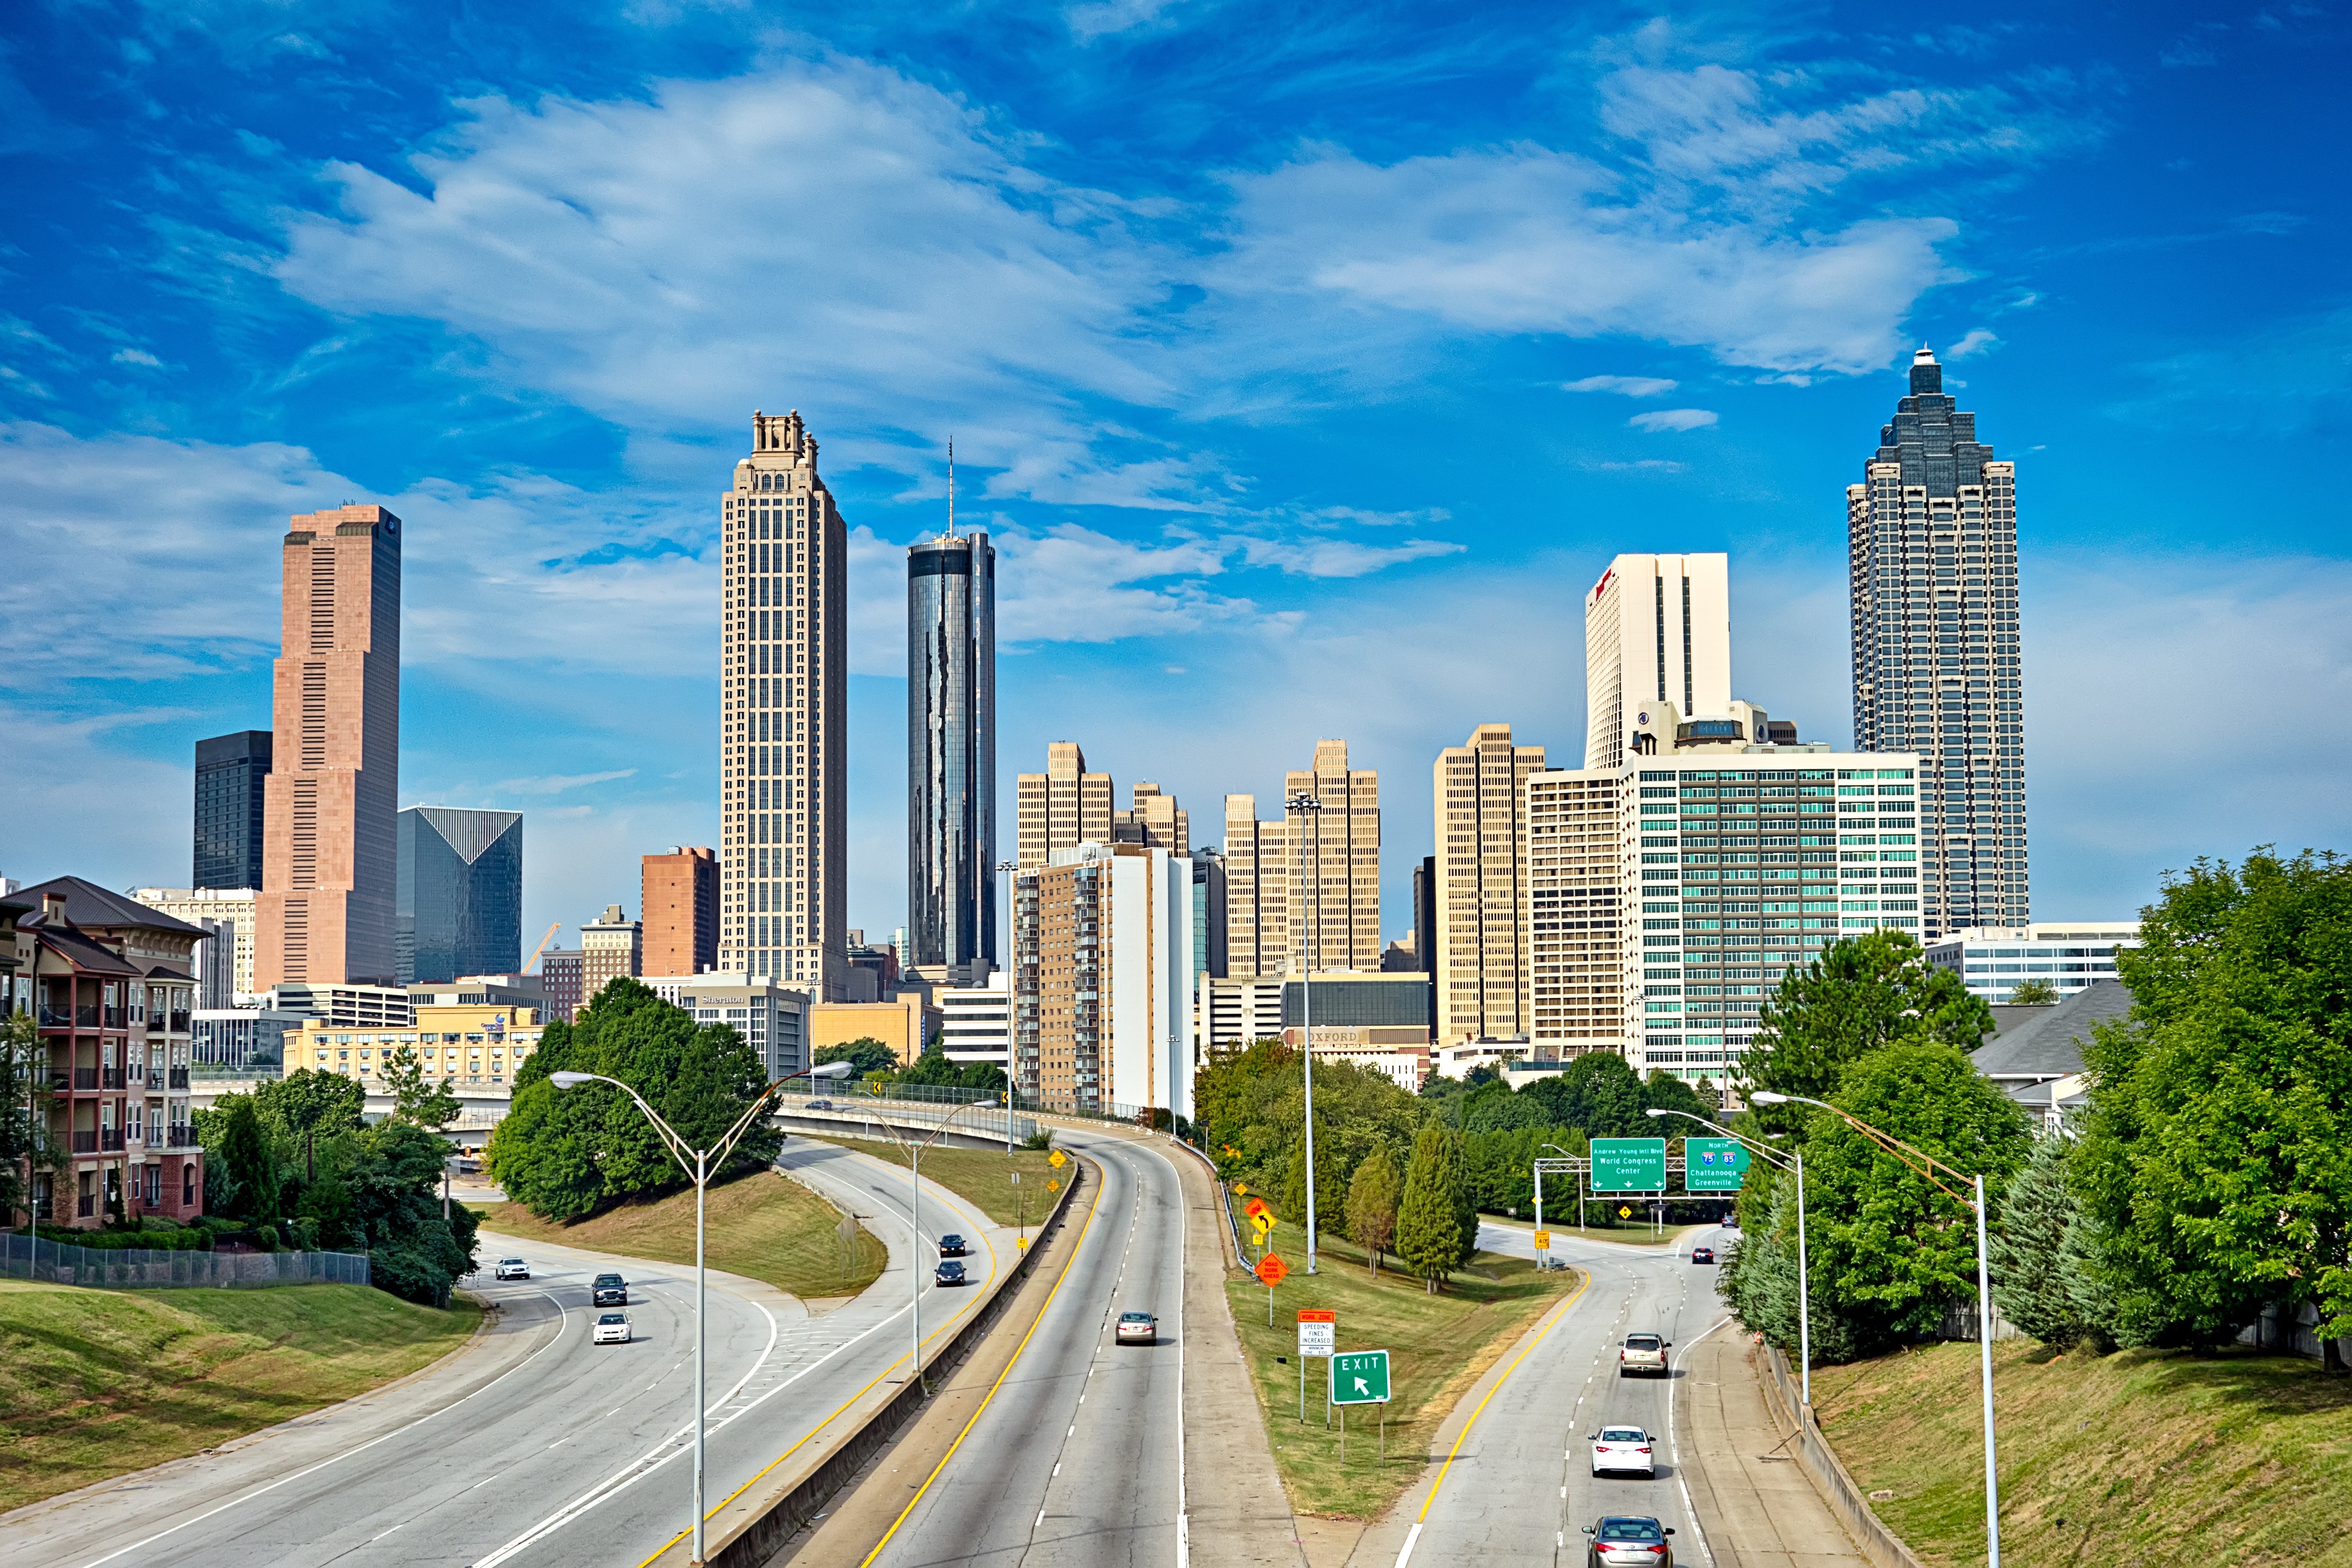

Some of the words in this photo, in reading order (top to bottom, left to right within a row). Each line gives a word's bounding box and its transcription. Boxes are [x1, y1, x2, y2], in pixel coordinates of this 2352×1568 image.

[702, 995, 744, 1004] Sheraton
[1310, 1033, 1356, 1041] OXFORD
[1342, 1357, 1378, 1370] EXIT
